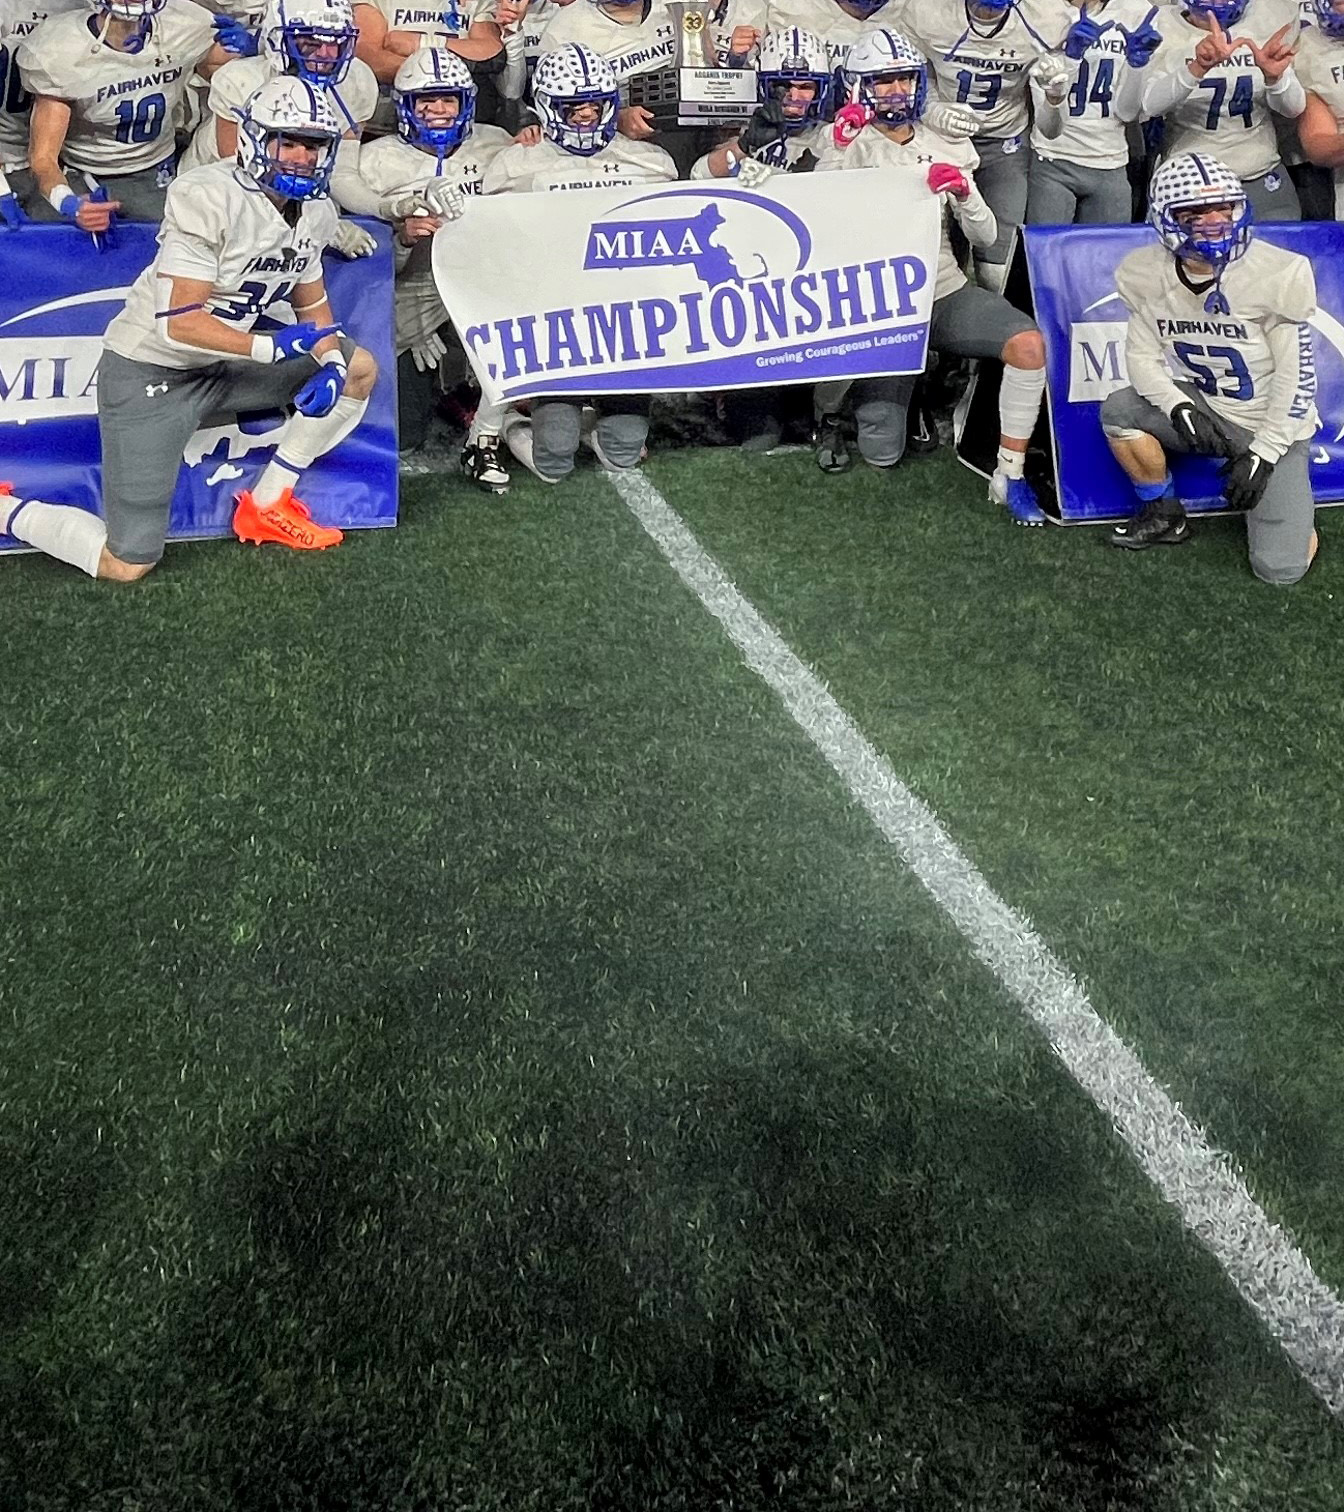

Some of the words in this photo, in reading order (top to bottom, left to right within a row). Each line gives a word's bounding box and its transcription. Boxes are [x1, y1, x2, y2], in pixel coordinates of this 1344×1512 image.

[955, 55, 1024, 72] AIRHAVEN
[97, 67, 183, 102] FAIRHAVEN
[956, 69, 1001, 110] 13
[1199, 74, 1254, 130] 74
[115, 93, 166, 143] 10
[594, 227, 704, 260] MIAA
[465, 255, 928, 381] CHAMPIONSHIP
[1157, 319, 1249, 340] FAIRHAVEN
[756, 350, 804, 368] Growing
[805, 337, 872, 360] Courageous
[1173, 341, 1254, 401] 53
[1288, 323, 1316, 421] AIRHAVEN
